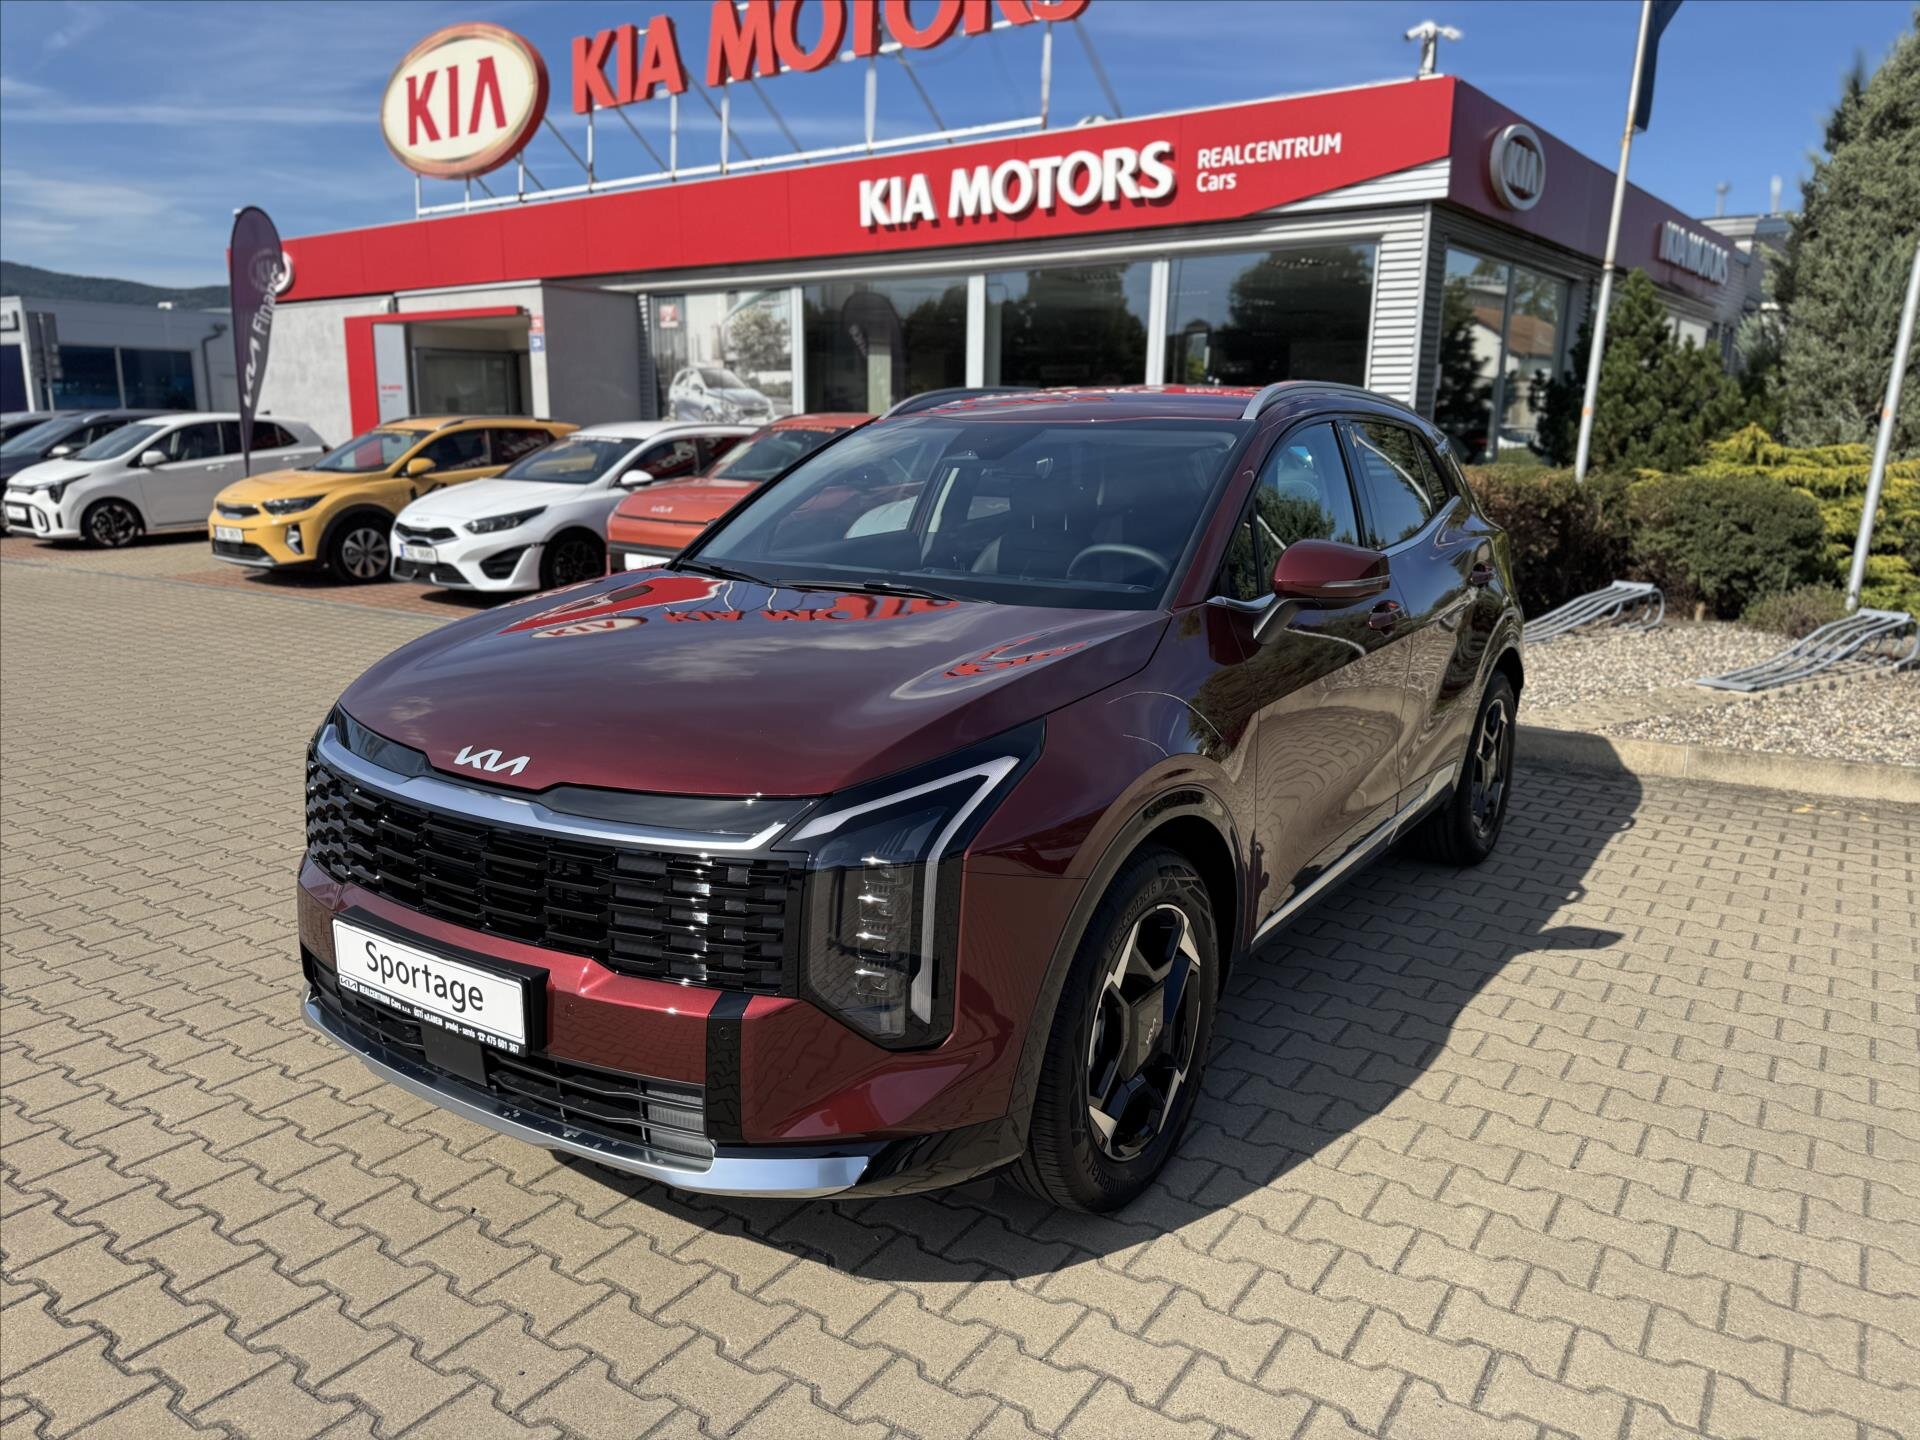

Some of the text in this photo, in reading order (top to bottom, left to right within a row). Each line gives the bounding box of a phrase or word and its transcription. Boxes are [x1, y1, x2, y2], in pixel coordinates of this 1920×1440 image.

[571, 15, 686, 113] KIA
[405, 55, 508, 146] KIA
[1195, 170, 1237, 193] Cars
[1196, 131, 1342, 170] REALCENTRUM
[1506, 139, 1539, 196] KIA
[859, 140, 1176, 230] KIA MOTORS
[1661, 219, 1729, 286] KIA MOTORS
[453, 744, 531, 776] KIA
[365, 940, 484, 1014] Sportage
[487, 1034, 497, 1047] 475
